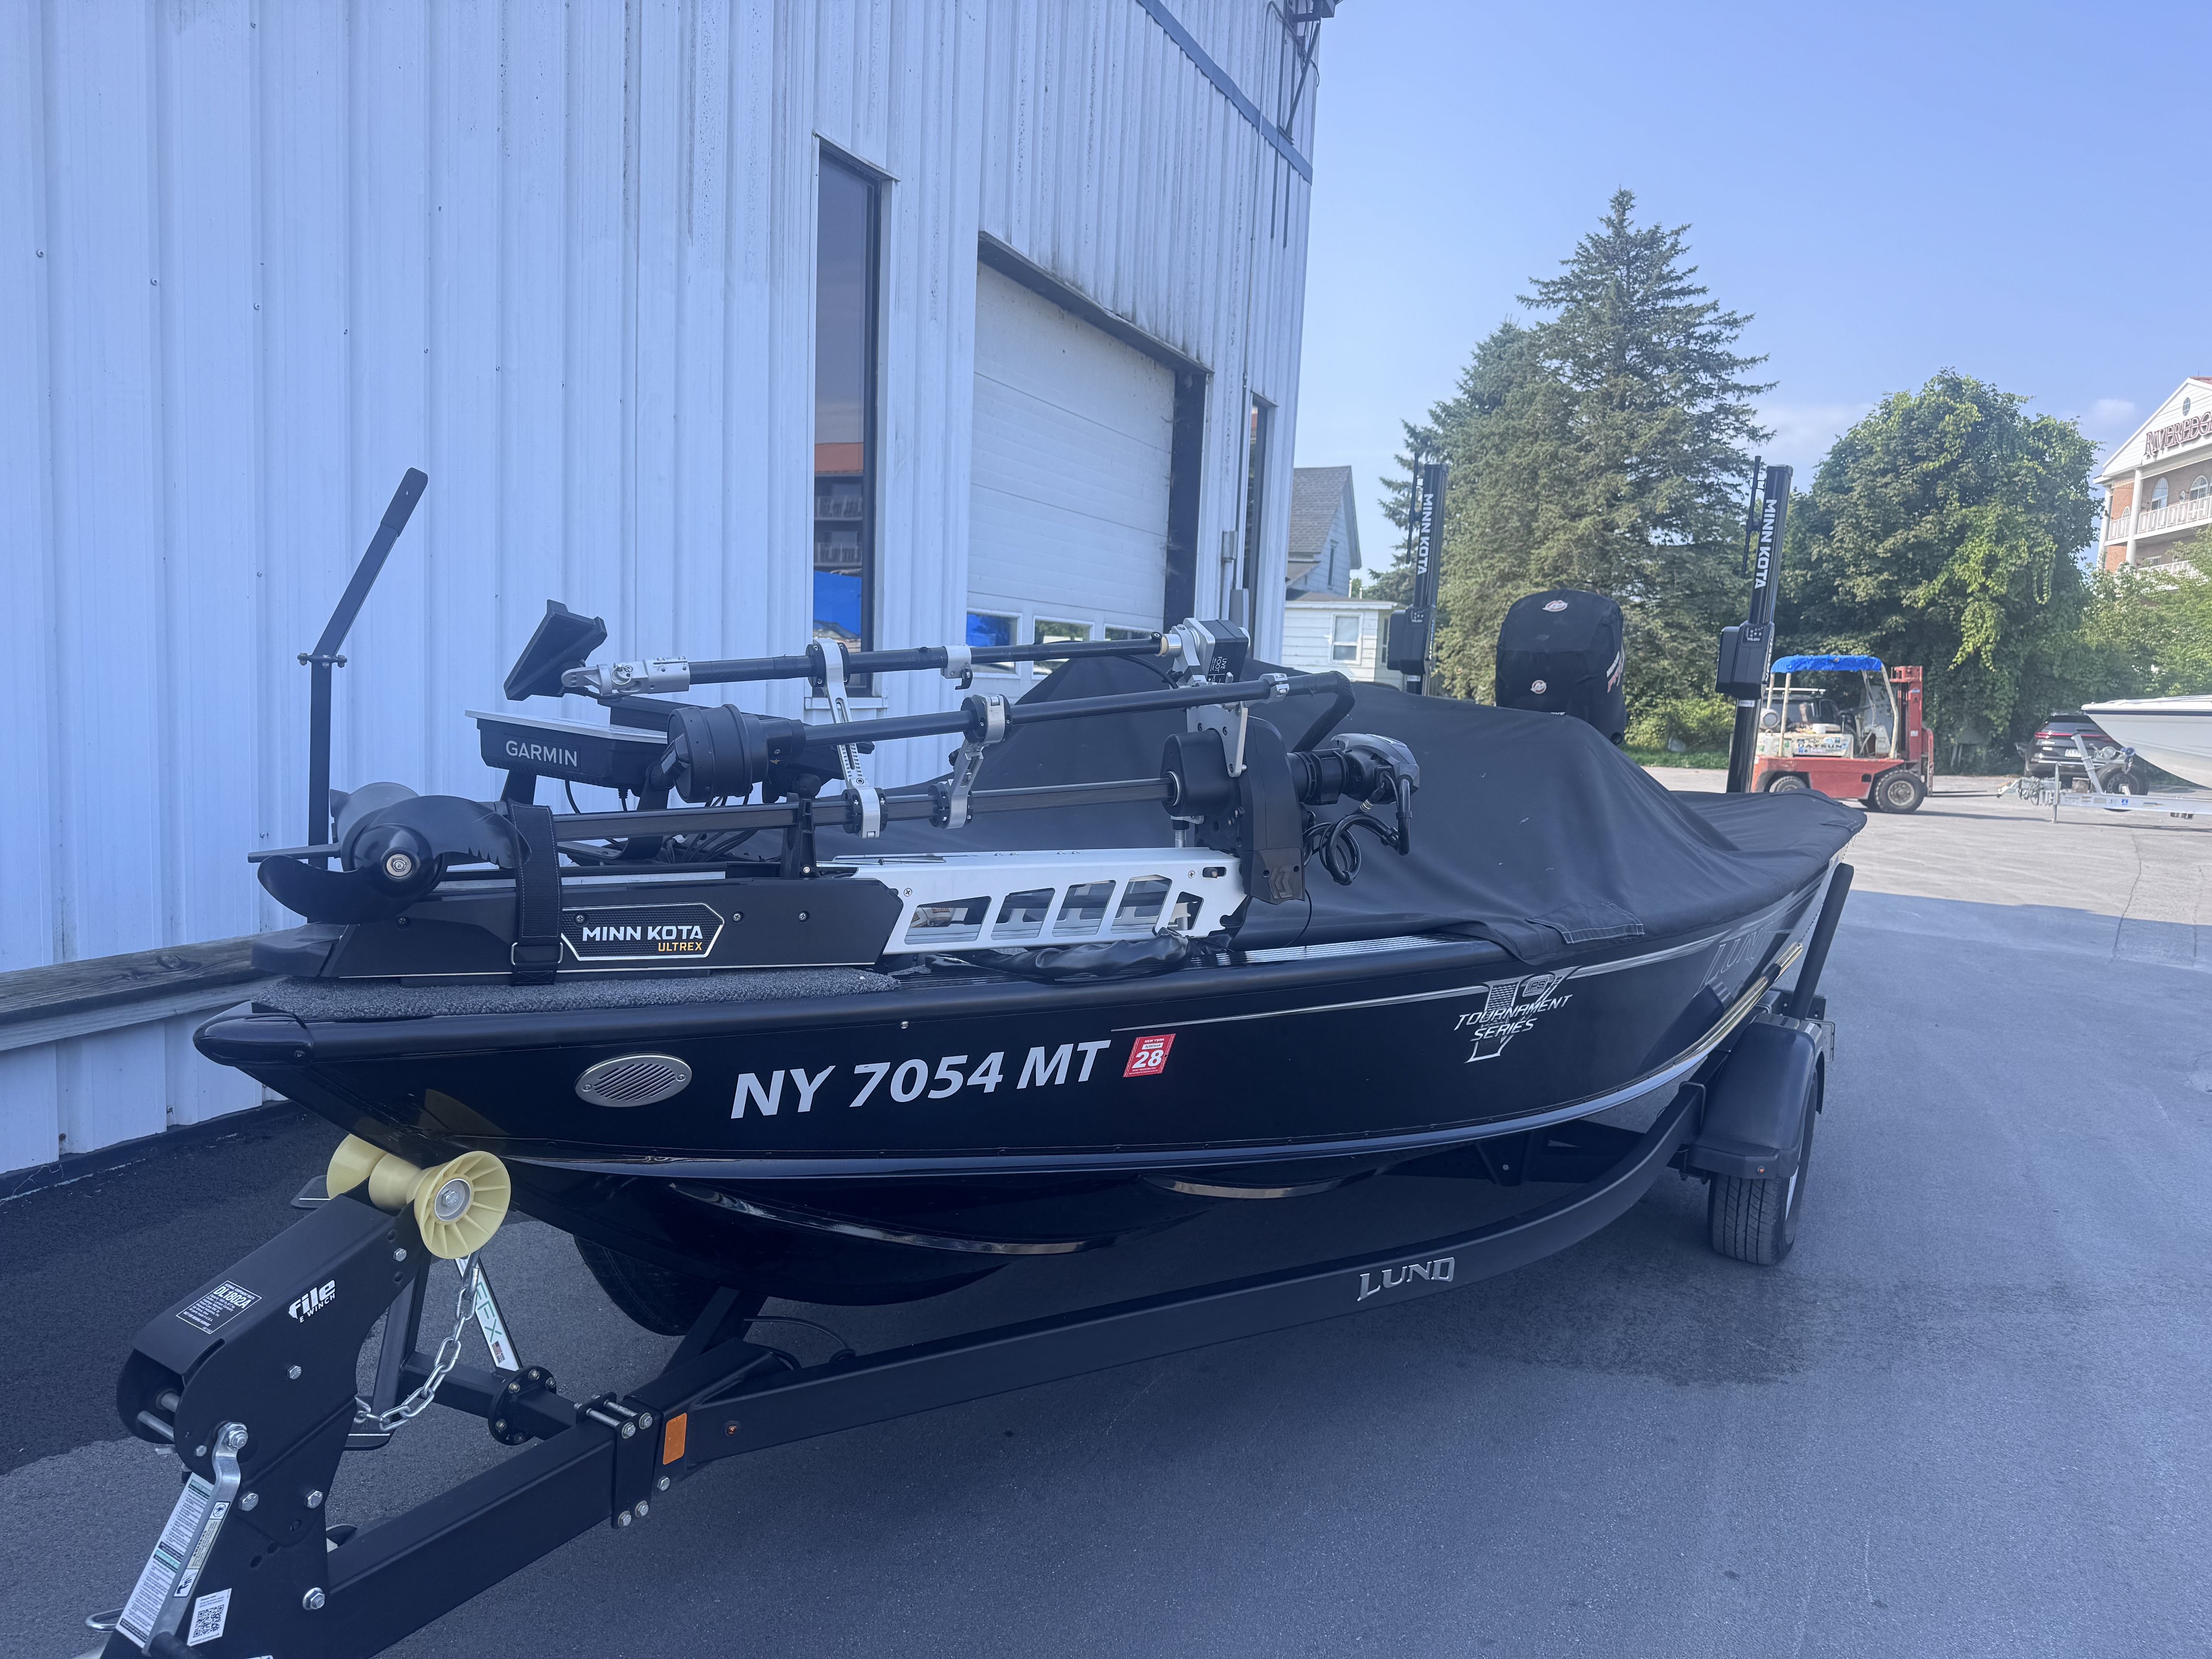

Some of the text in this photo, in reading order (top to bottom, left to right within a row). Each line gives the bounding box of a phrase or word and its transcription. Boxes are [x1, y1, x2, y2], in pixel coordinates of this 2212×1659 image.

[1417, 493, 1434, 575] MINN KOTA
[1754, 499, 1777, 589] MINN KOTA
[1214, 656, 1223, 673] FOOT
[506, 740, 577, 767] GARMIN
[582, 926, 703, 941] MINN KOTA
[658, 942, 702, 952] ULTREX
[1454, 994, 1573, 1031] TOURNAMENT
[1470, 1018, 1538, 1041] SERIES
[1132, 1049, 1164, 1068] 28
[731, 1040, 1111, 1118] NY 7054 MT
[1357, 1257, 1455, 1301] LUND
[213, 1286, 252, 1309] DL1802A
[307, 1293, 335, 1317] WINCH
[195, 1530, 207, 1553] WARNING
